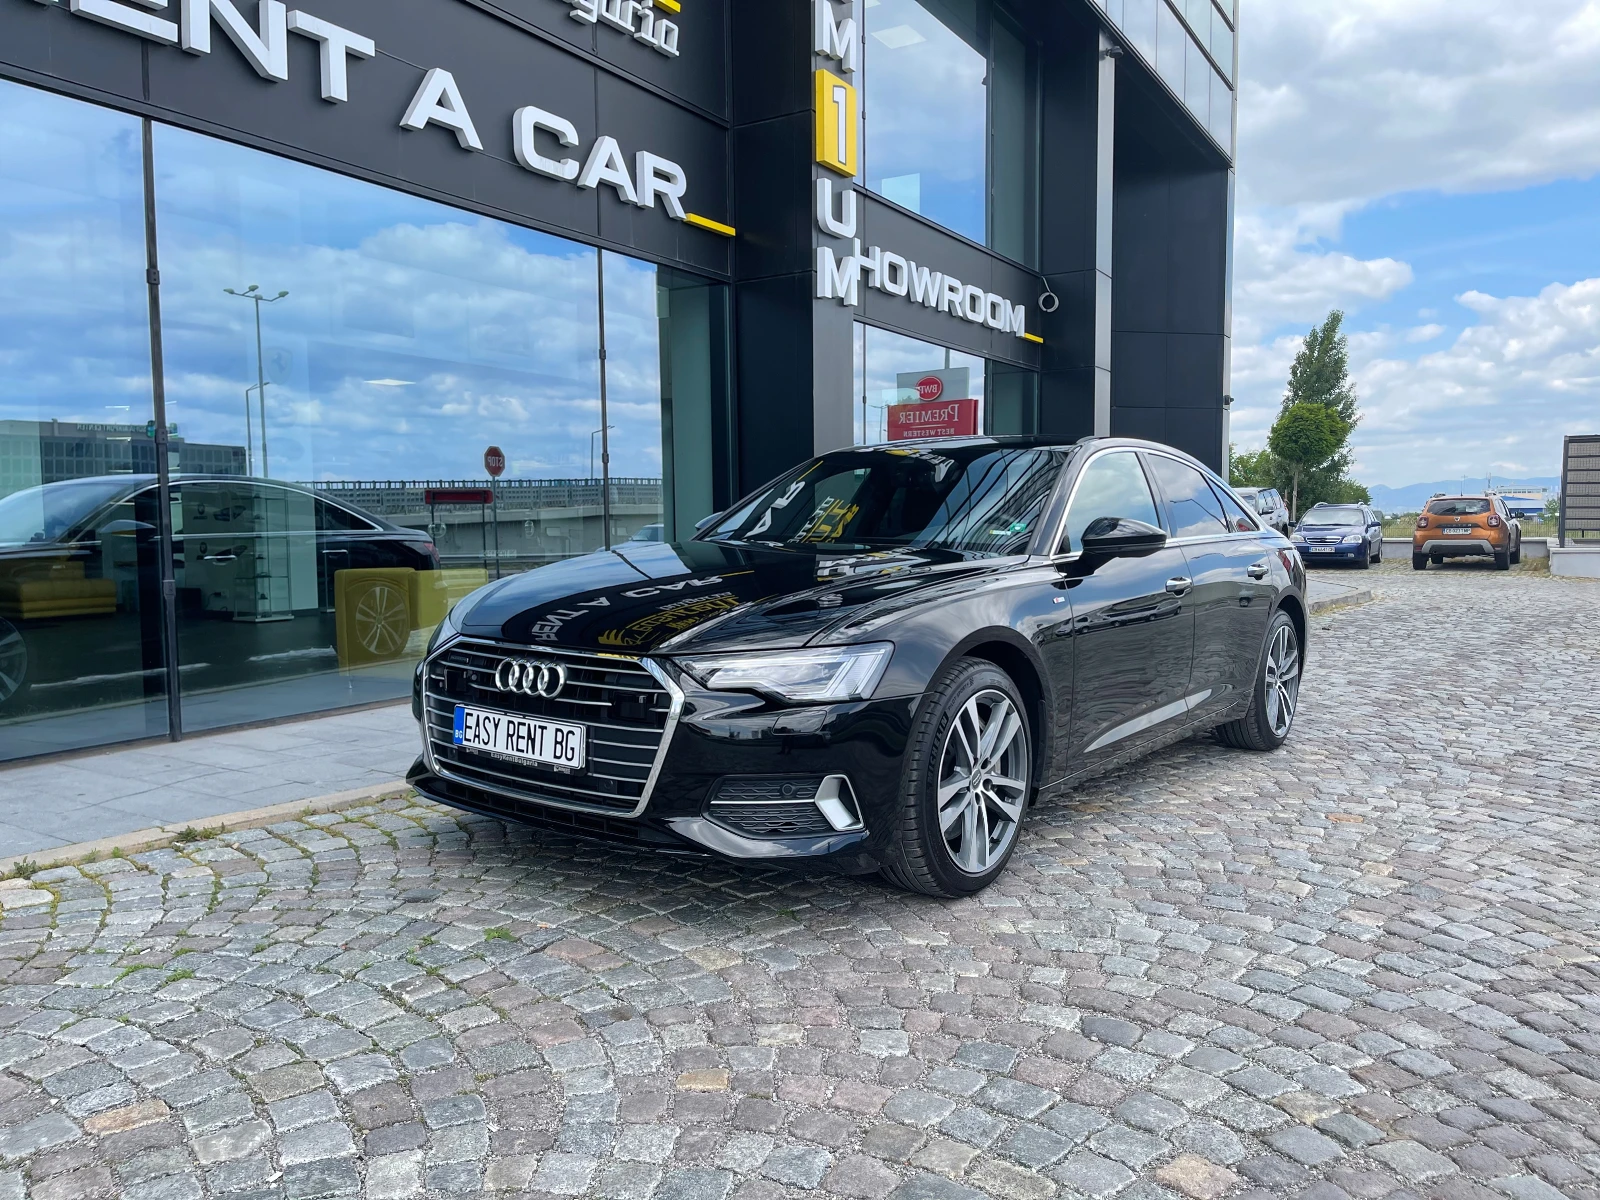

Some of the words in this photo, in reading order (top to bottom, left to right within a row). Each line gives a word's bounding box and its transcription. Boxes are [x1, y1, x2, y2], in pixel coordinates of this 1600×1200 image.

[399, 67, 484, 152] A
[513, 105, 687, 221] CAR
[853, 237, 1026, 338] HOWROOM
[455, 729, 463, 739] BG
[464, 712, 501, 748] EASY
[506, 719, 548, 757] RENT
[553, 728, 576, 762] BG
